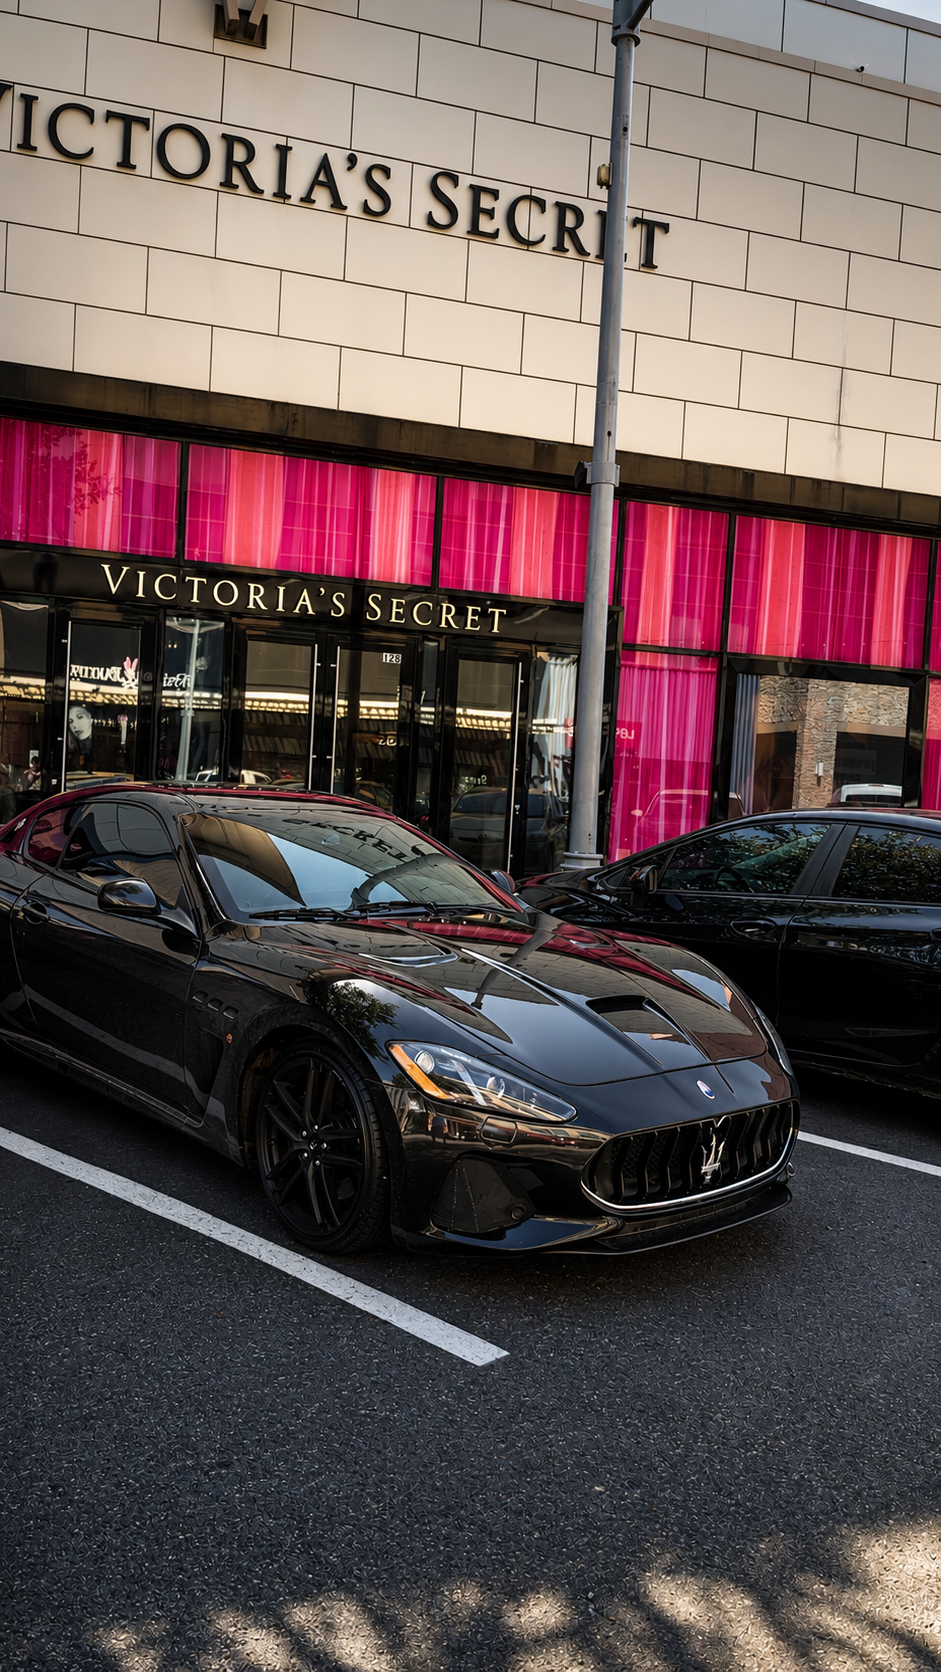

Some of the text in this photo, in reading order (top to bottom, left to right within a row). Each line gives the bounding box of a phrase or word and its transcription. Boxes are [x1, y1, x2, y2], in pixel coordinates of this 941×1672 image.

[101, 564, 507, 633] VICTORIA'S SECRET
[384, 653, 401, 663] 128
